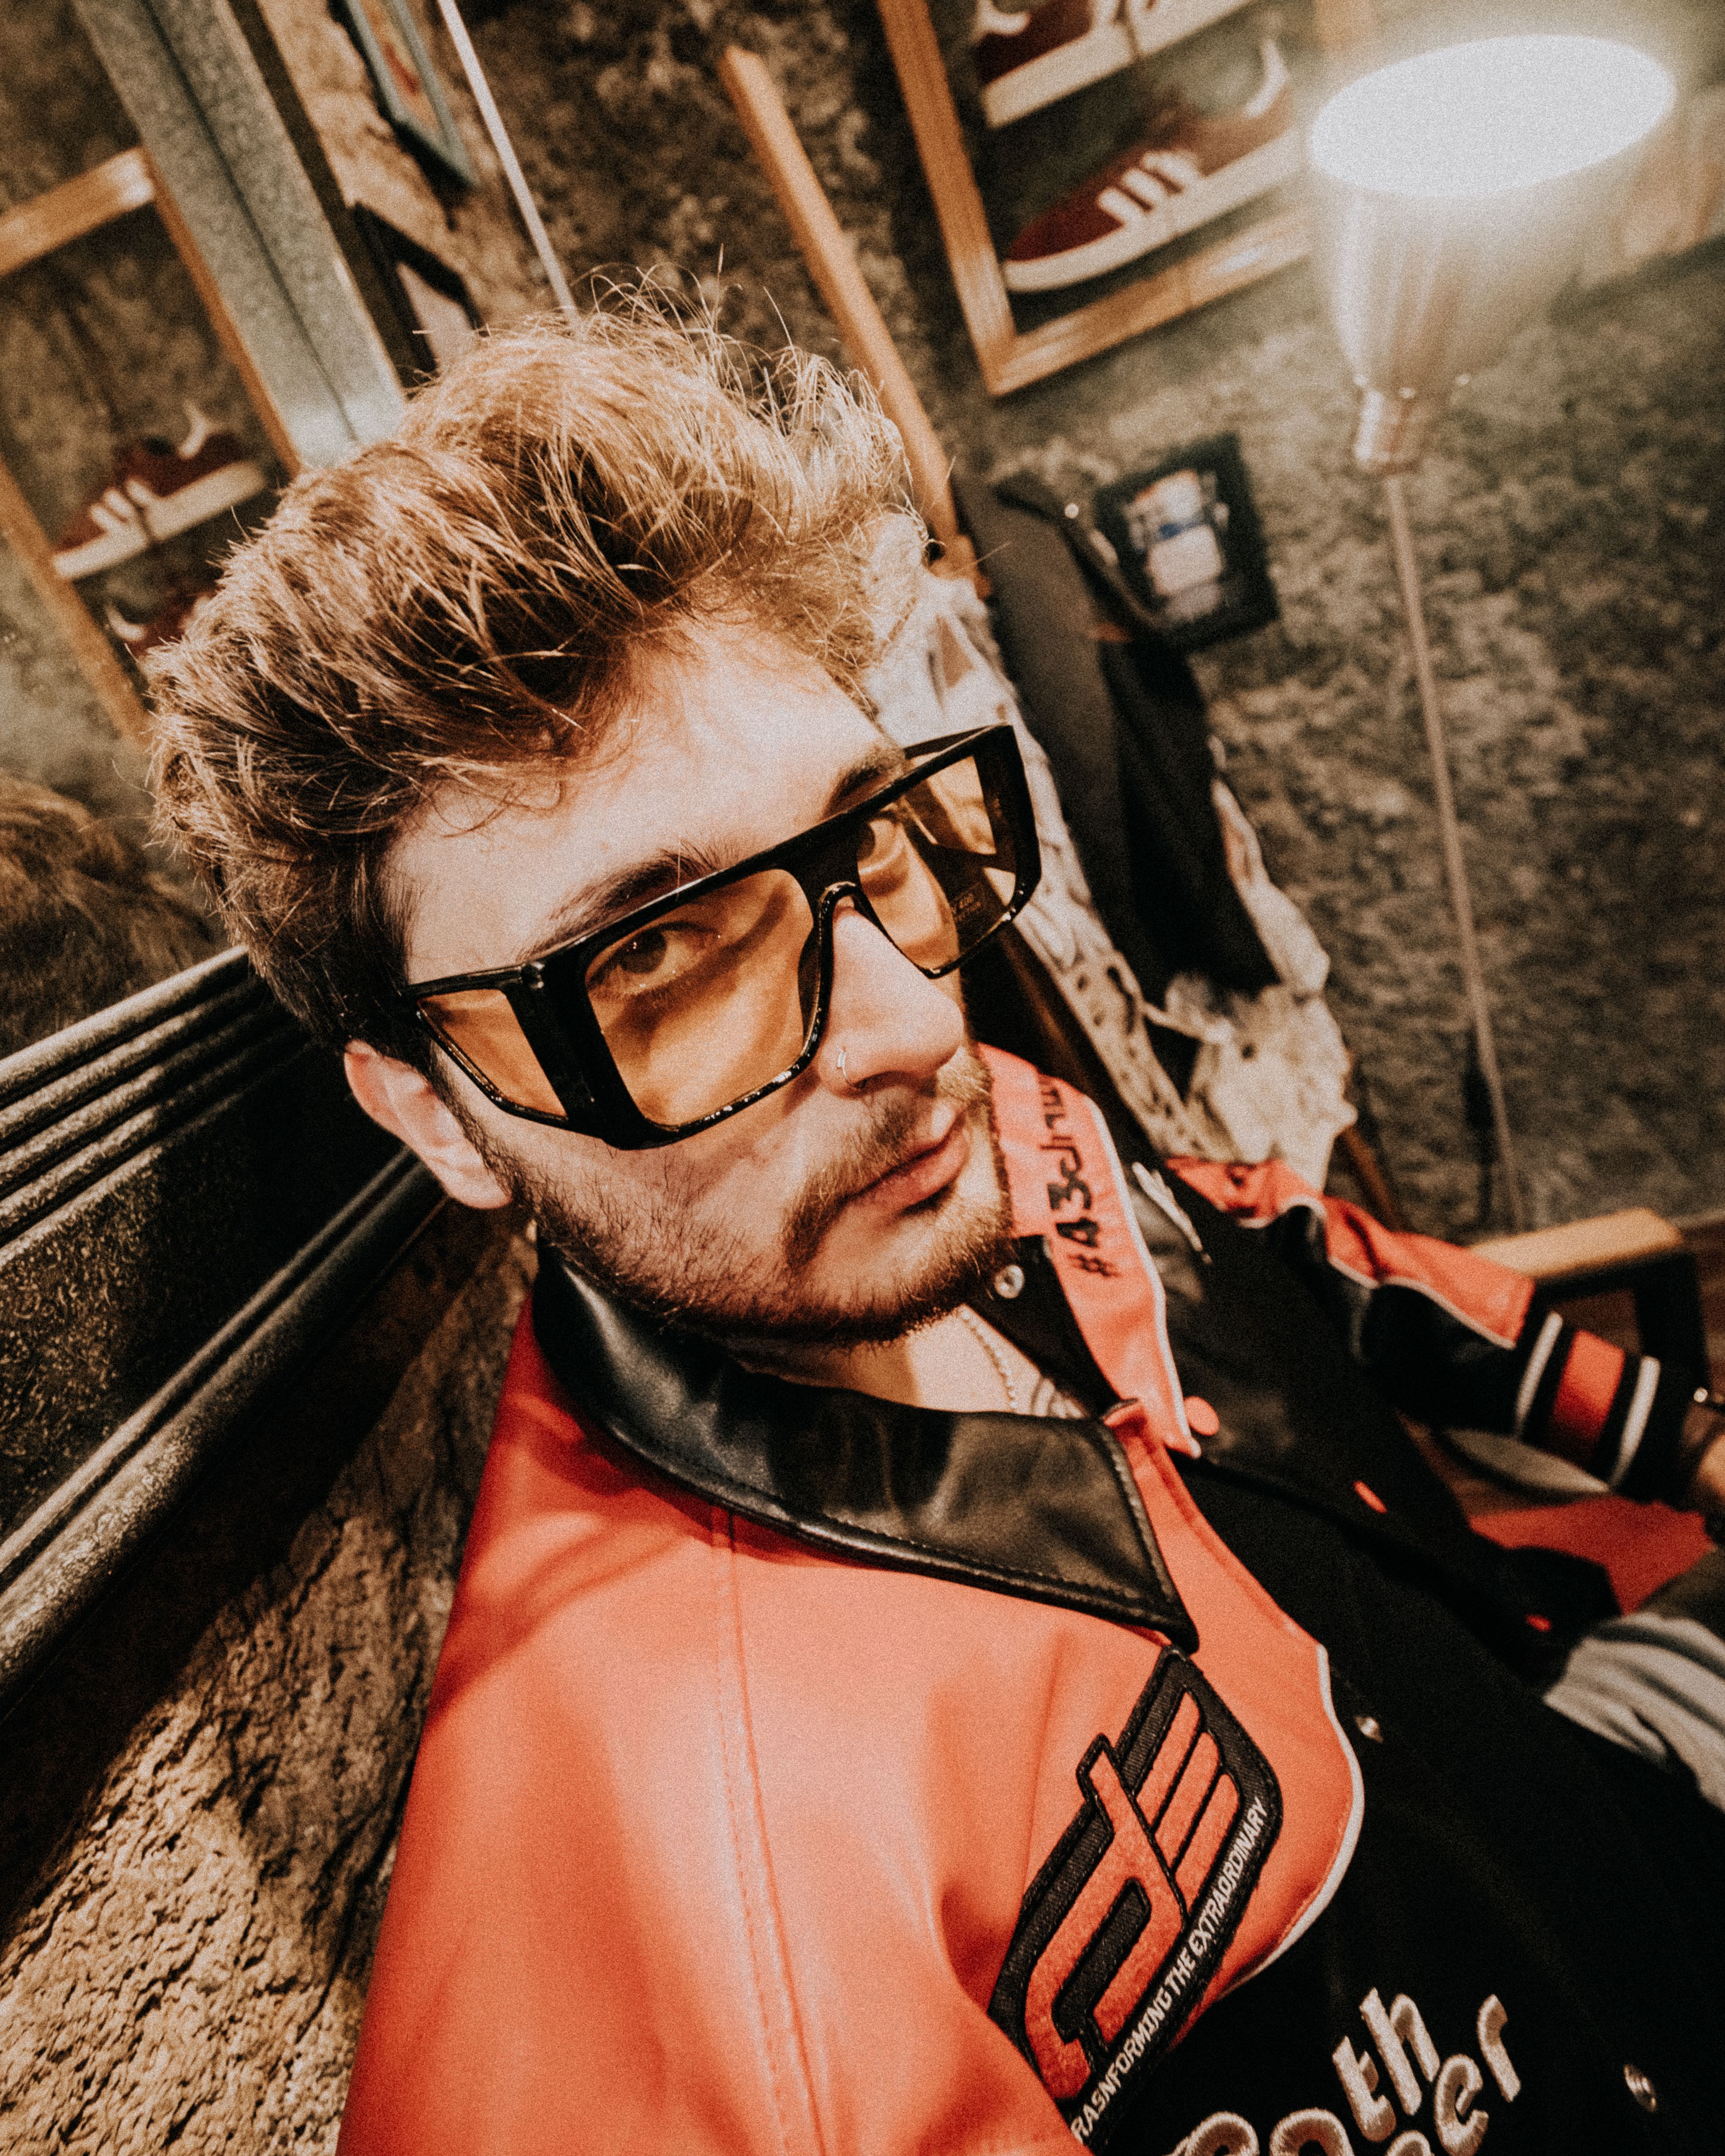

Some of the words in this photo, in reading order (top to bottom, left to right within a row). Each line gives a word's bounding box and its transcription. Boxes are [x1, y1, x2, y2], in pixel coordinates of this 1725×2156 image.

[1071, 1987, 1172, 2143] RASNFORMING
[1164, 1947, 1196, 1996] THE
[1188, 1796, 1267, 1957] EXTRAORDINARY
